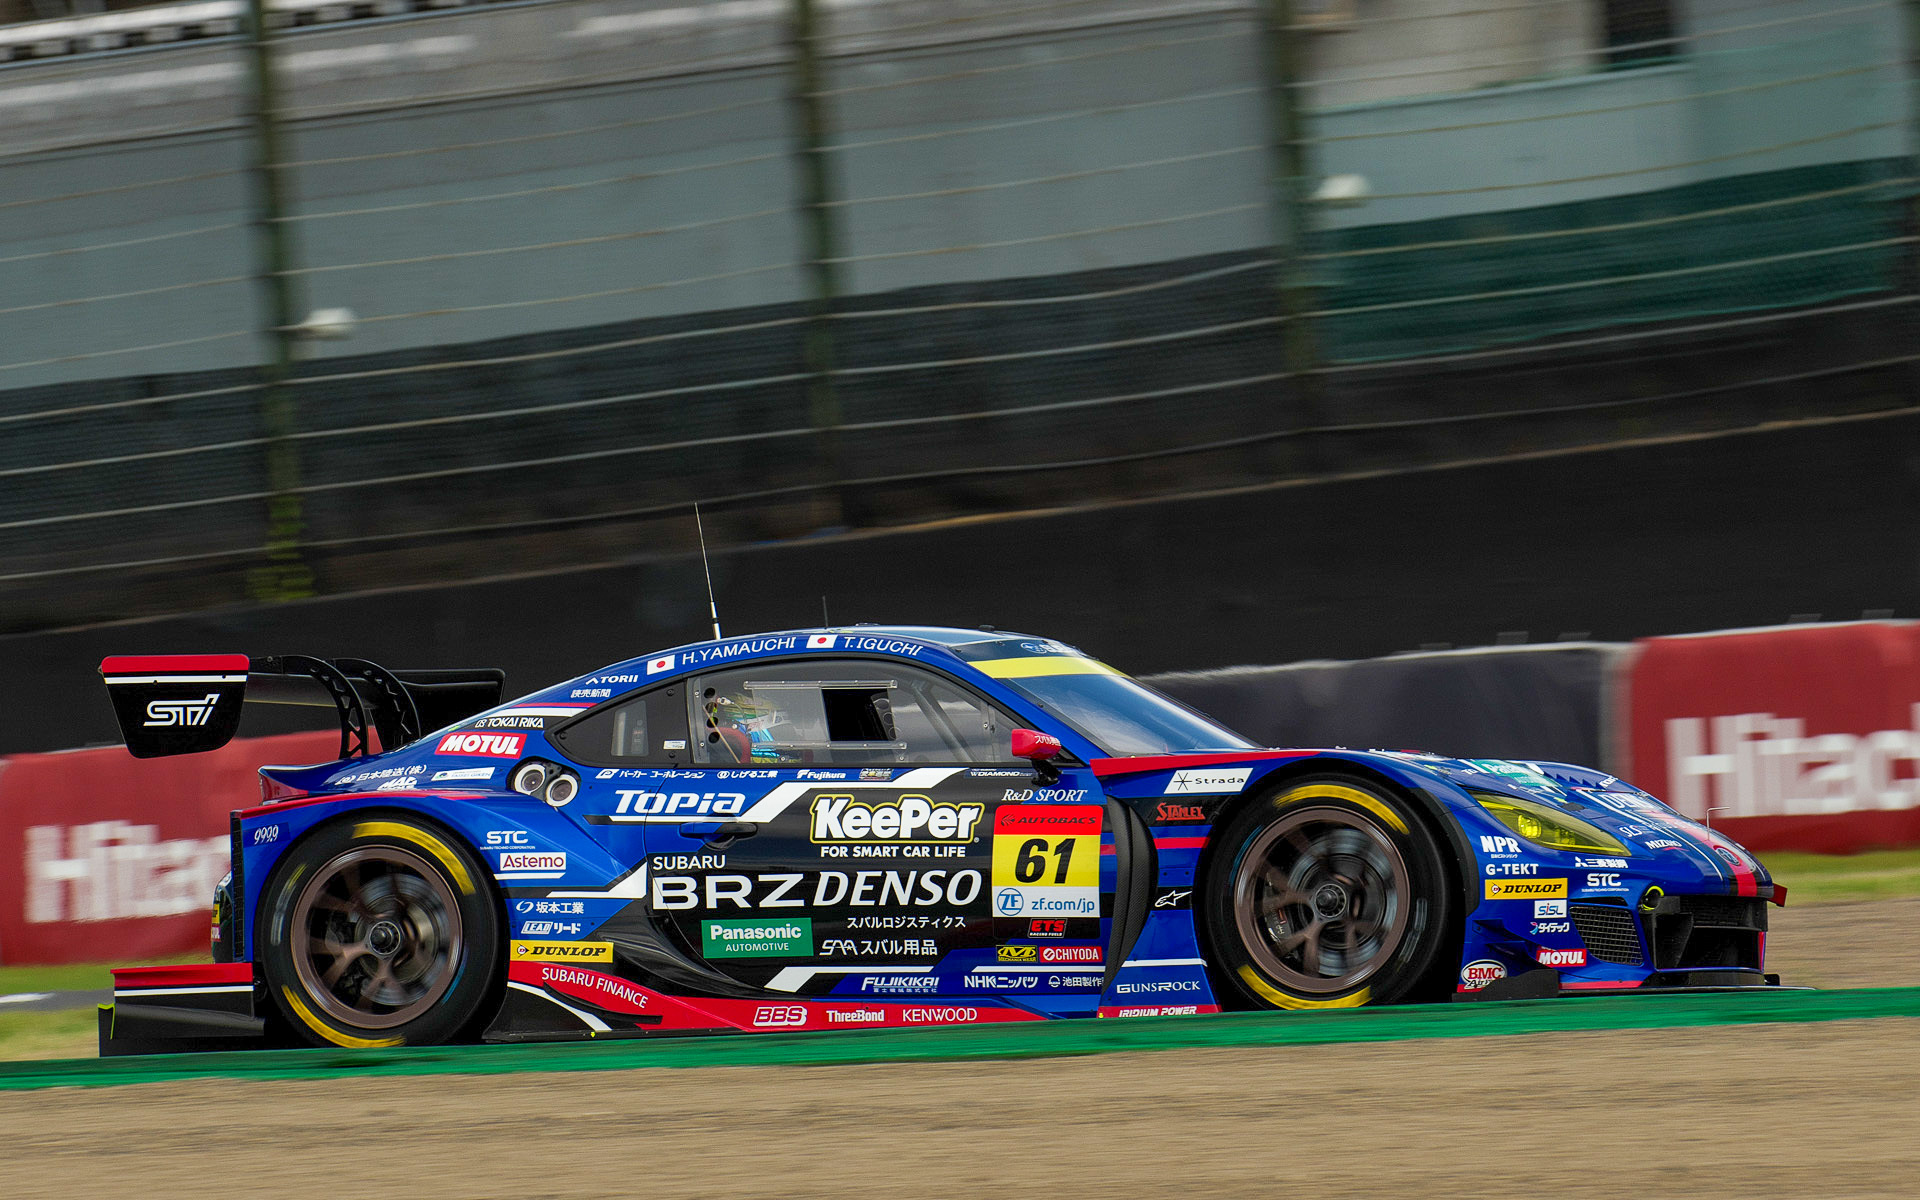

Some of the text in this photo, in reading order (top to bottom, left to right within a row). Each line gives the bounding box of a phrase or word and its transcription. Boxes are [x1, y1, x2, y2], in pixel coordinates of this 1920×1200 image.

[682, 637, 796, 665] H.YAMAUCHI
[843, 636, 924, 656] T.IGUCHI
[600, 675, 638, 684] TORII
[488, 717, 544, 728] TOKAI RIKA
[439, 734, 520, 755] MOTUL
[1664, 702, 1920, 819] Hitac
[619, 770, 705, 778] パーカー コーポレーション
[731, 770, 778, 778] しげる工業
[807, 772, 846, 780] Fujikura
[1195, 777, 1245, 785] Strada
[1001, 789, 1088, 802] R&D SPORT
[811, 797, 981, 840] KeePer
[1156, 803, 1205, 821] STANLEY
[1018, 817, 1096, 825] AUTOBACS
[486, 831, 529, 844] STC
[1480, 835, 1522, 853] NPR
[820, 846, 966, 858] FOR SMART CAR LIFE
[503, 855, 564, 868] Astemo
[652, 855, 726, 871] SUBARU
[1015, 838, 1076, 884] 61
[1485, 863, 1539, 875] G-TEKT
[1587, 873, 1621, 886] STC
[652, 874, 805, 910] BRZ
[812, 869, 983, 907] DENSO
[1503, 884, 1562, 893] DUNLOP
[536, 902, 584, 914] 坂本工業
[1031, 898, 1095, 913] zf.com/jp
[554, 923, 581, 934] リード
[847, 916, 967, 929] スバルロジスティクス
[1031, 920, 1065, 932] ETS
[710, 923, 802, 940] Panasonic
[531, 946, 606, 957] DUNLOP
[725, 942, 789, 952] AUTOMOTIVE
[861, 939, 938, 956] スバル用品
[1056, 948, 1099, 960] CHIYODA
[1538, 951, 1584, 964] MOTUL
[1468, 967, 1503, 979] BMC
[541, 967, 649, 1009] SUBARU FINANCE
[861, 977, 939, 990] FUJIKIKAI
[1062, 976, 1104, 987] 池田製作
[1117, 981, 1201, 993] GUNSROCK
[754, 1006, 807, 1026] BBS
[826, 1010, 885, 1022] ThreeBond
[902, 1008, 978, 1022] KENWOOD
[1118, 1006, 1197, 1018] IRIDIUM POWER
